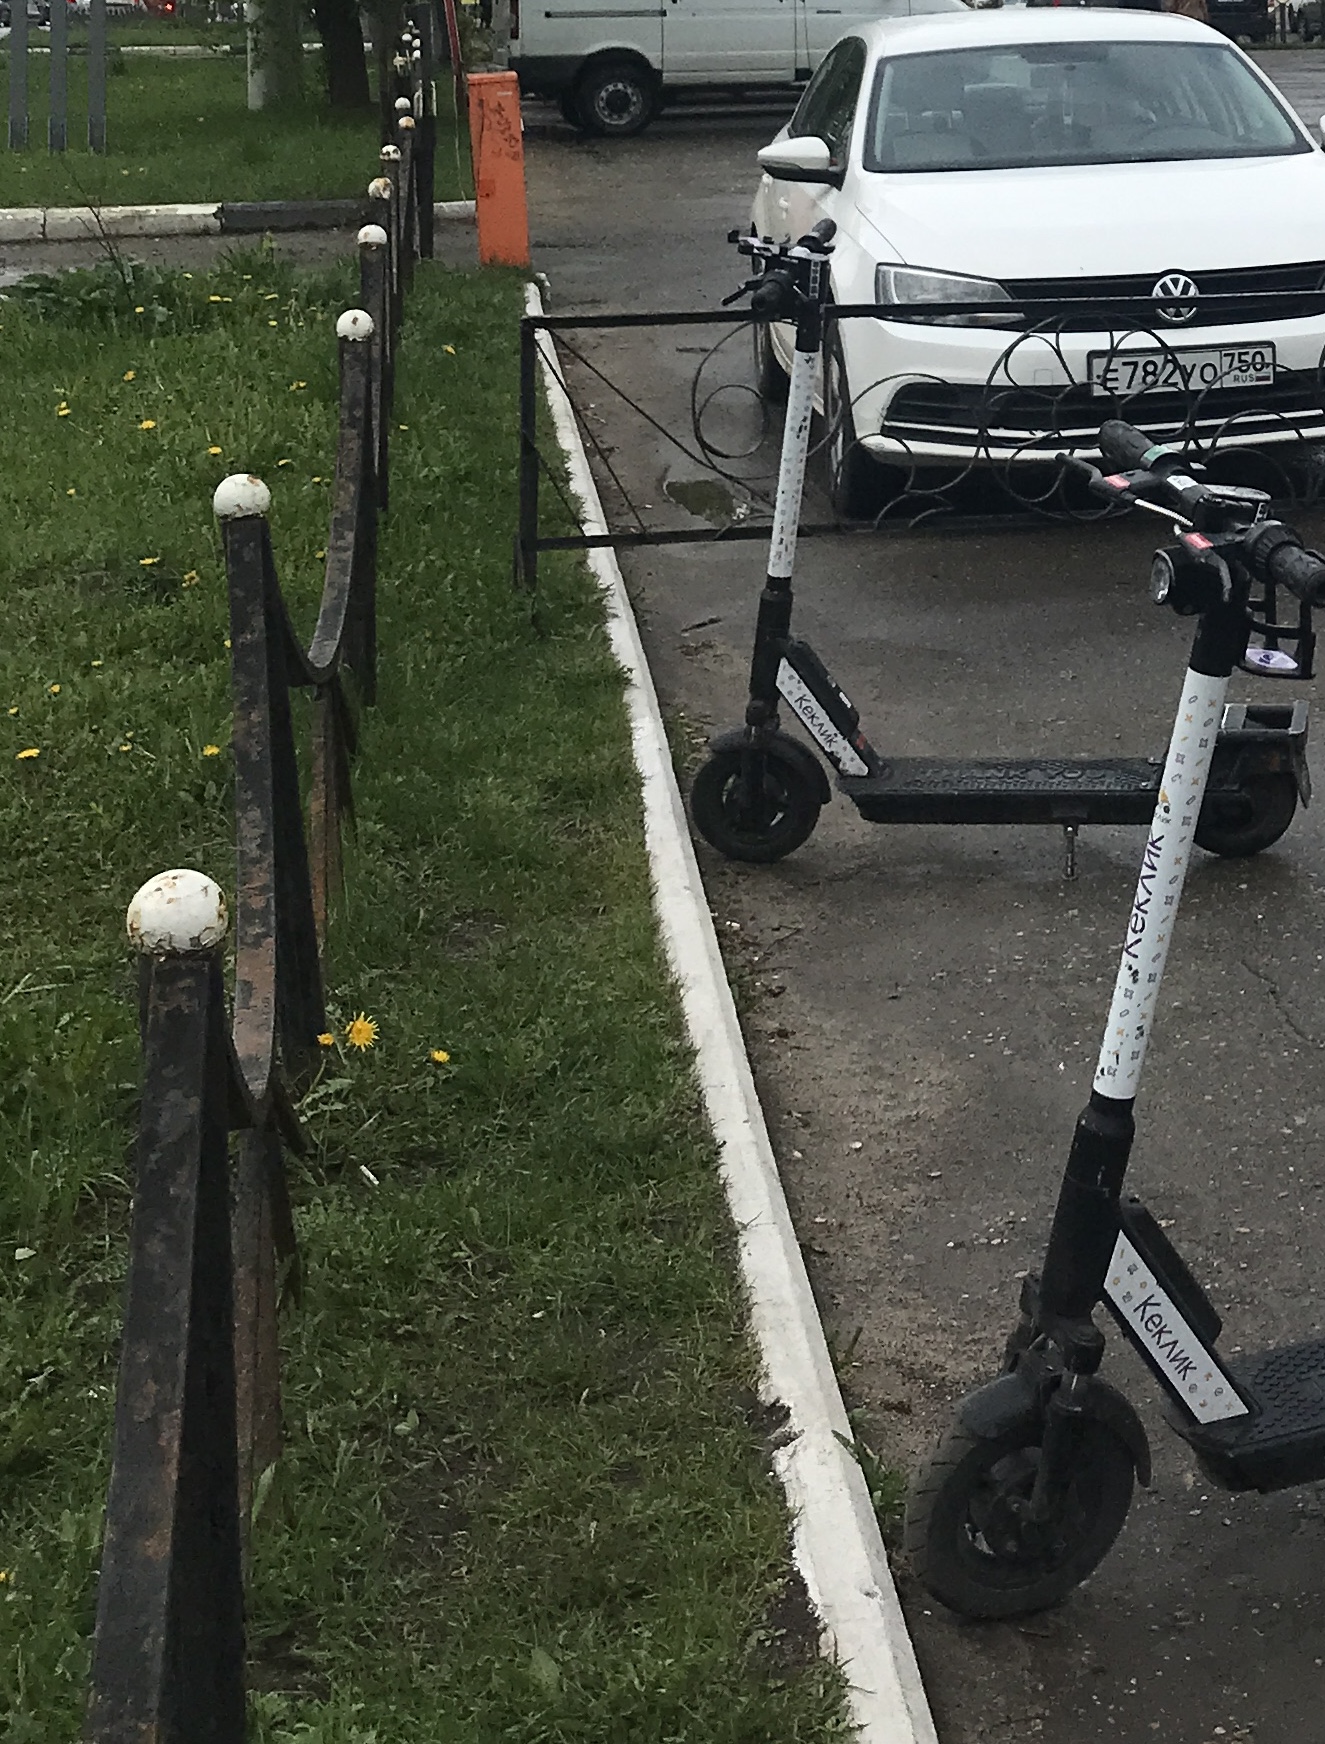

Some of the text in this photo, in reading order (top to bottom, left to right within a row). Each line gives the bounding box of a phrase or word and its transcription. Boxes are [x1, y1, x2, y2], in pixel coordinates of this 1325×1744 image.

[1223, 350, 1267, 373] 750
[1233, 373, 1255, 384] RUS
[1133, 1293, 1198, 1382] Кеклик
